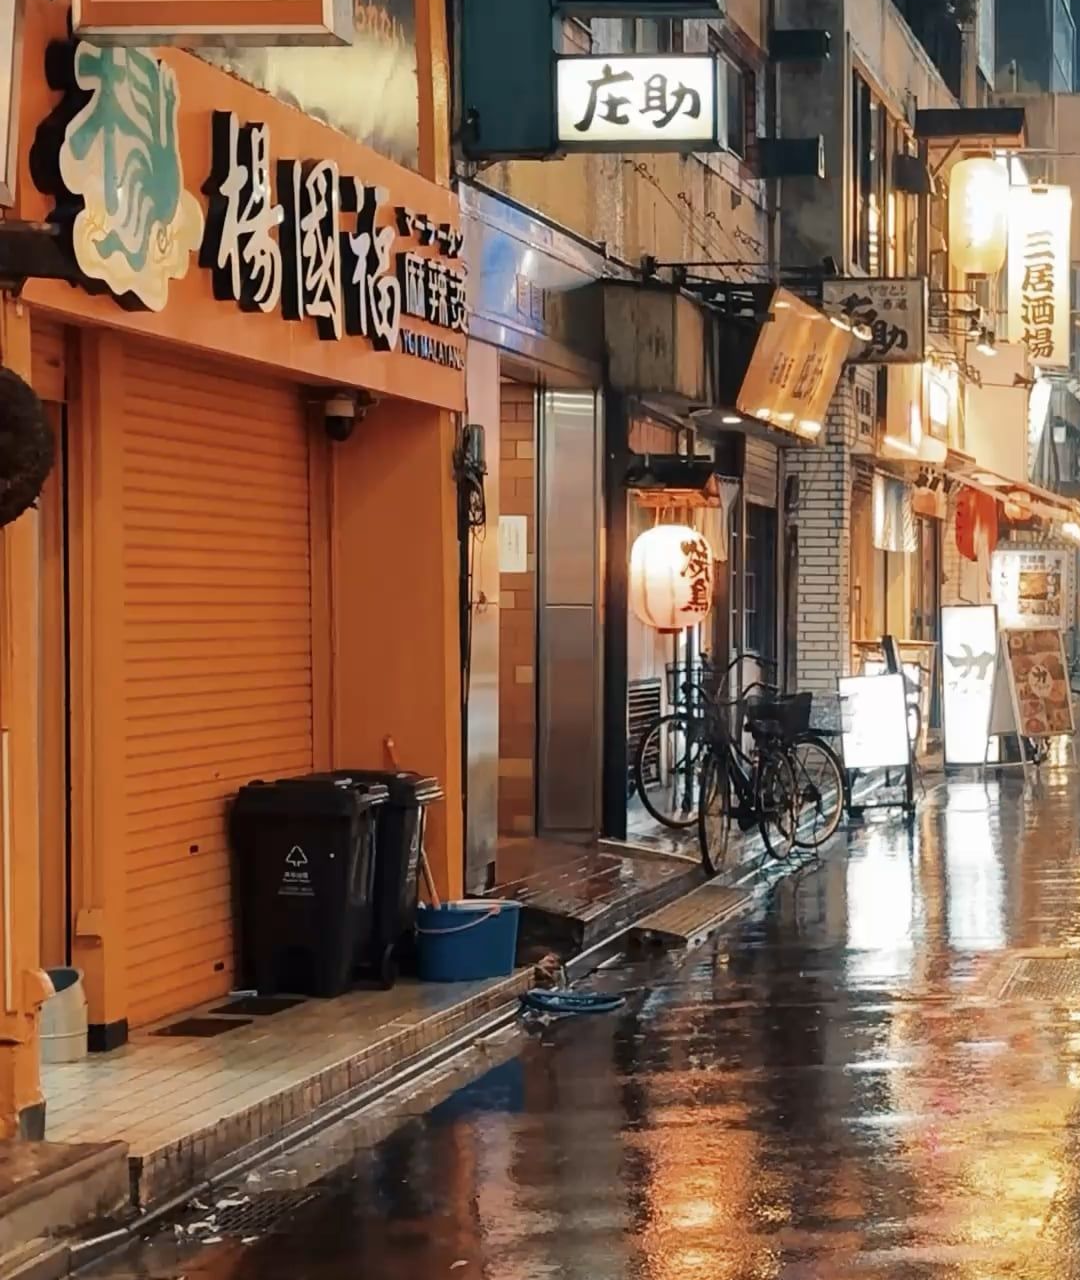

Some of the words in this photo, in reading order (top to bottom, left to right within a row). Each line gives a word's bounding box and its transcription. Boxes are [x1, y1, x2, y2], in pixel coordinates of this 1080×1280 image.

[574, 63, 703, 132] 庄助
[213, 111, 400, 352] 楊國福
